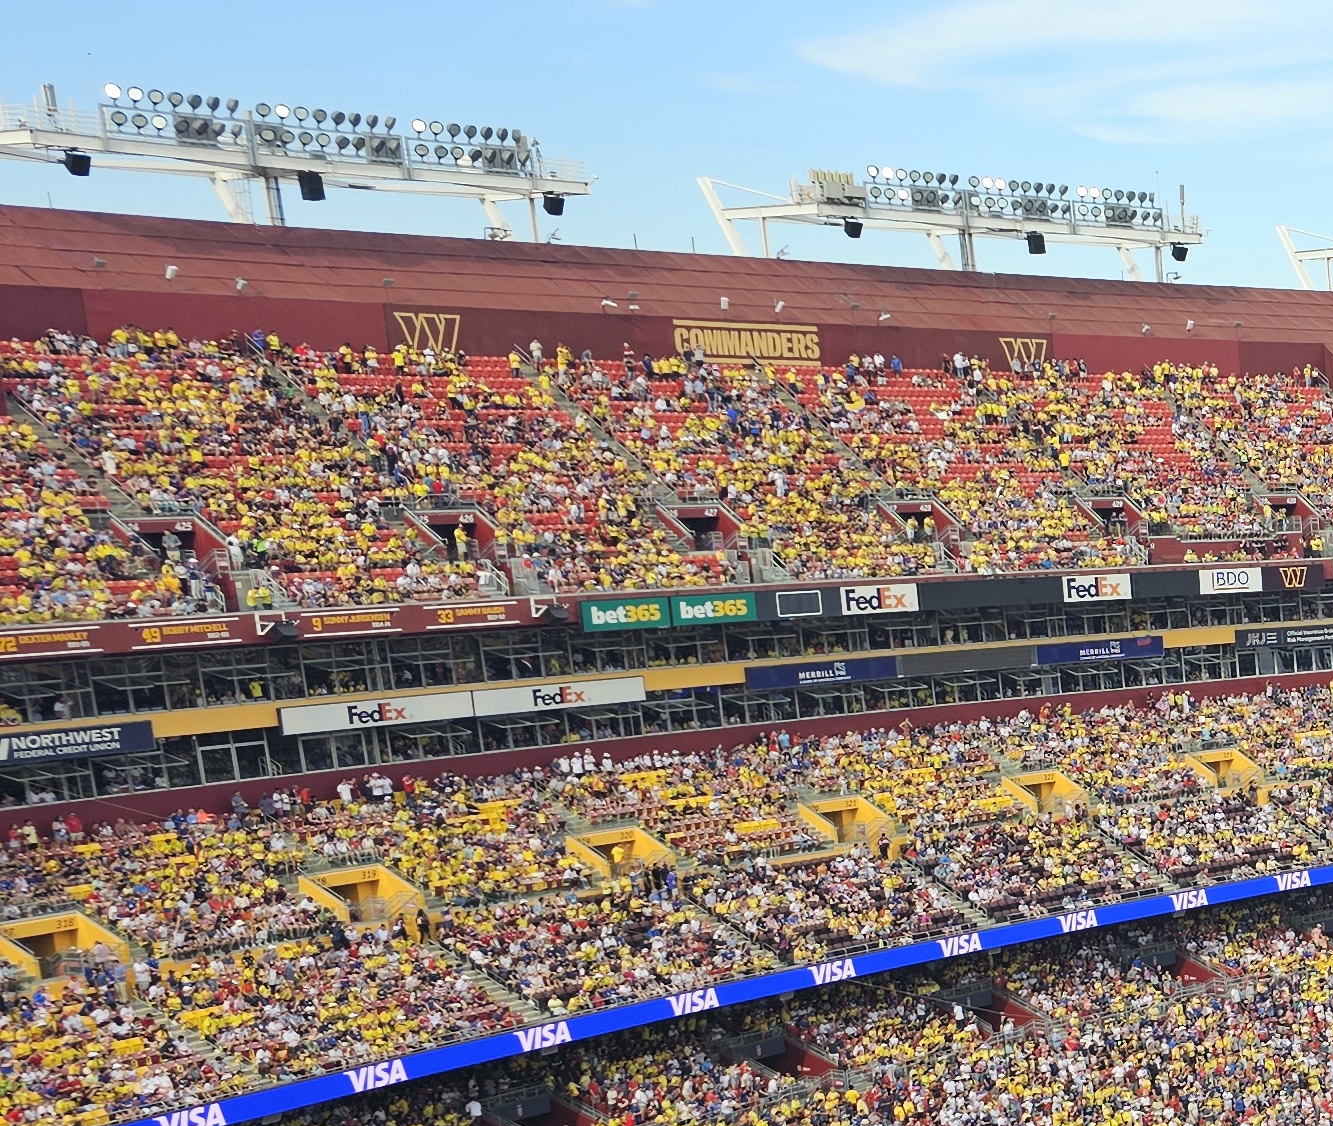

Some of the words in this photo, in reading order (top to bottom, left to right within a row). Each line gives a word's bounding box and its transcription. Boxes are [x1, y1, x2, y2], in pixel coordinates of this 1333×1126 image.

[673, 327, 821, 359] COMMANDERS
[174, 522, 193, 532] 425
[458, 514, 474, 523] 426
[1067, 577, 1121, 599] FedEx
[680, 599, 748, 619] bet365
[845, 587, 907, 611] FedEx
[312, 617, 322, 631] 9
[437, 609, 454, 624] 33
[591, 604, 661, 625] bet365
[142, 627, 161, 644] 49
[798, 669, 834, 680] MERRILL
[532, 686, 586, 707] FedEx
[347, 702, 407, 724] FedEx
[12, 727, 122, 750] NORTHWEST
[13, 745, 49, 759] FEDERAL
[50, 743, 86, 756] CREDIT
[89, 741, 121, 754] UNION
[844, 800, 857, 808] 321
[620, 830, 634, 840] 320
[361, 870, 377, 878] 319
[1273, 870, 1311, 891] VISA
[1169, 888, 1209, 911] VISA
[56, 918, 74, 929] 318
[1056, 909, 1099, 932] VISA
[936, 932, 982, 957] VISA
[807, 958, 857, 987] VISA
[665, 987, 720, 1017] VISA
[513, 1021, 572, 1052] VISA
[343, 1058, 408, 1093] VISA
